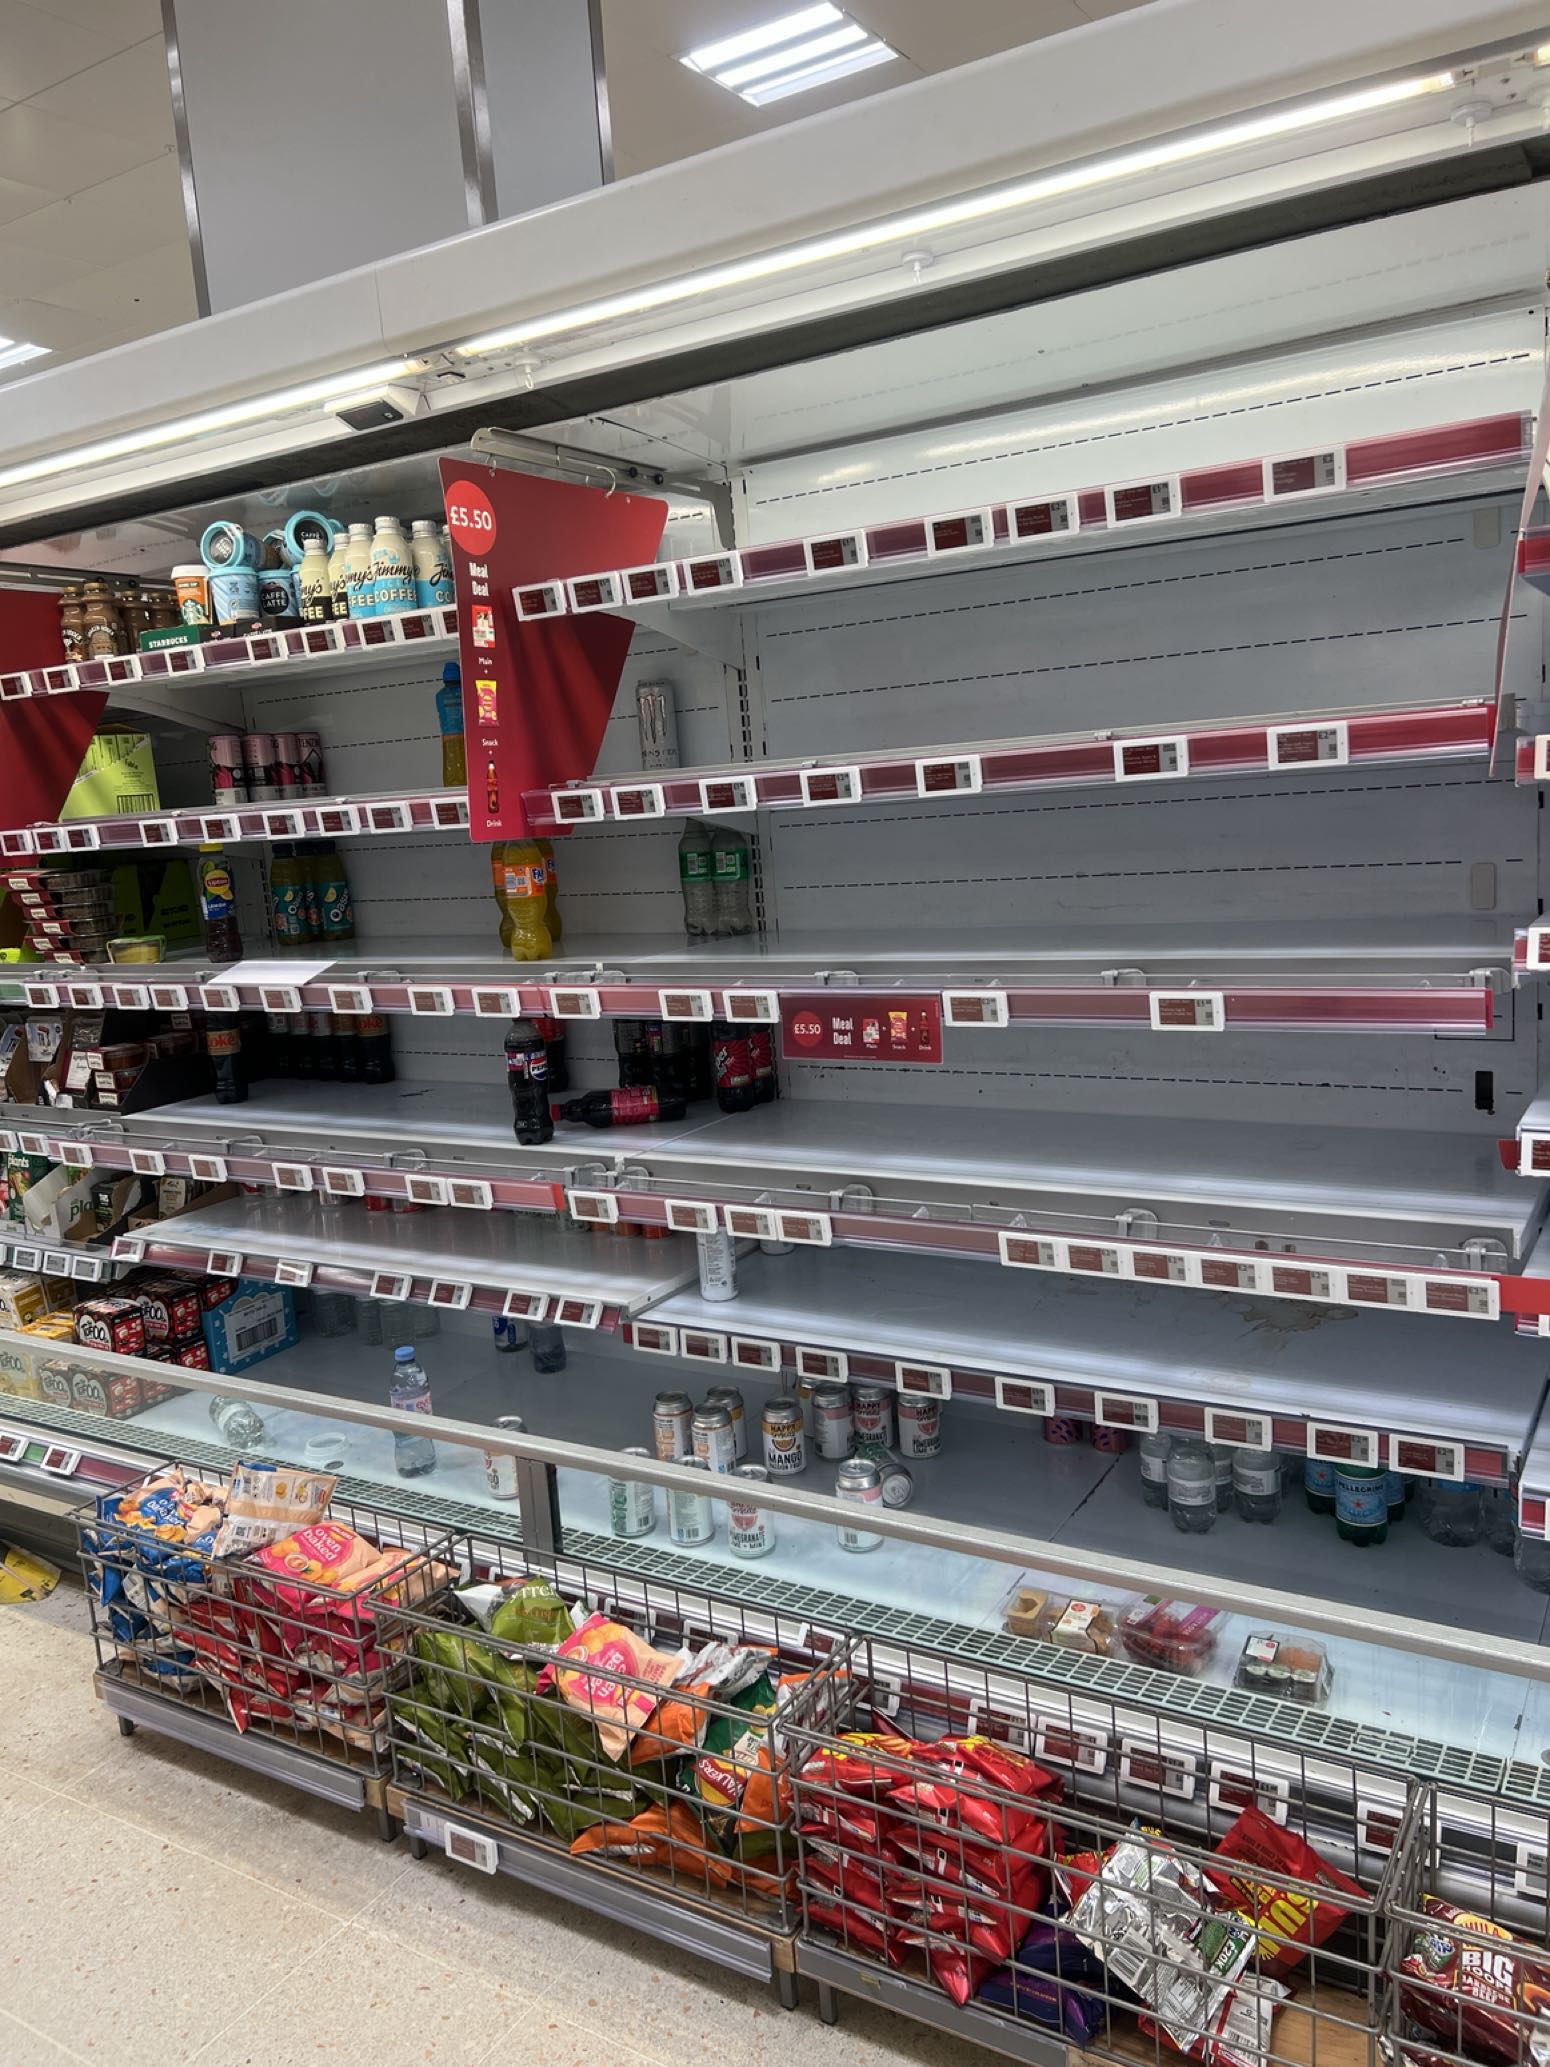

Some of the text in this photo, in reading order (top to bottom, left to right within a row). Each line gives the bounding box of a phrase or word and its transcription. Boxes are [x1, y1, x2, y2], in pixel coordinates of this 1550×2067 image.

[450, 505, 492, 531] £5.50
[469, 562, 488, 578] Meal
[471, 580, 489, 596] Deal
[348, 594, 375, 608] FEE
[148, 635, 188, 649] STARBUCKS
[479, 657, 493, 666] Main
[482, 738, 499, 747] Snack
[486, 819, 503, 828] Drink
[207, 877, 229, 886] Lipton
[794, 1023, 822, 1035] £5.50
[832, 1017, 854, 1031] Meal
[833, 1032, 852, 1046] Deal
[303, 1529, 337, 1560] baked
[315, 1528, 341, 1552] oven
[1462, 1951, 1515, 1988] BIG
